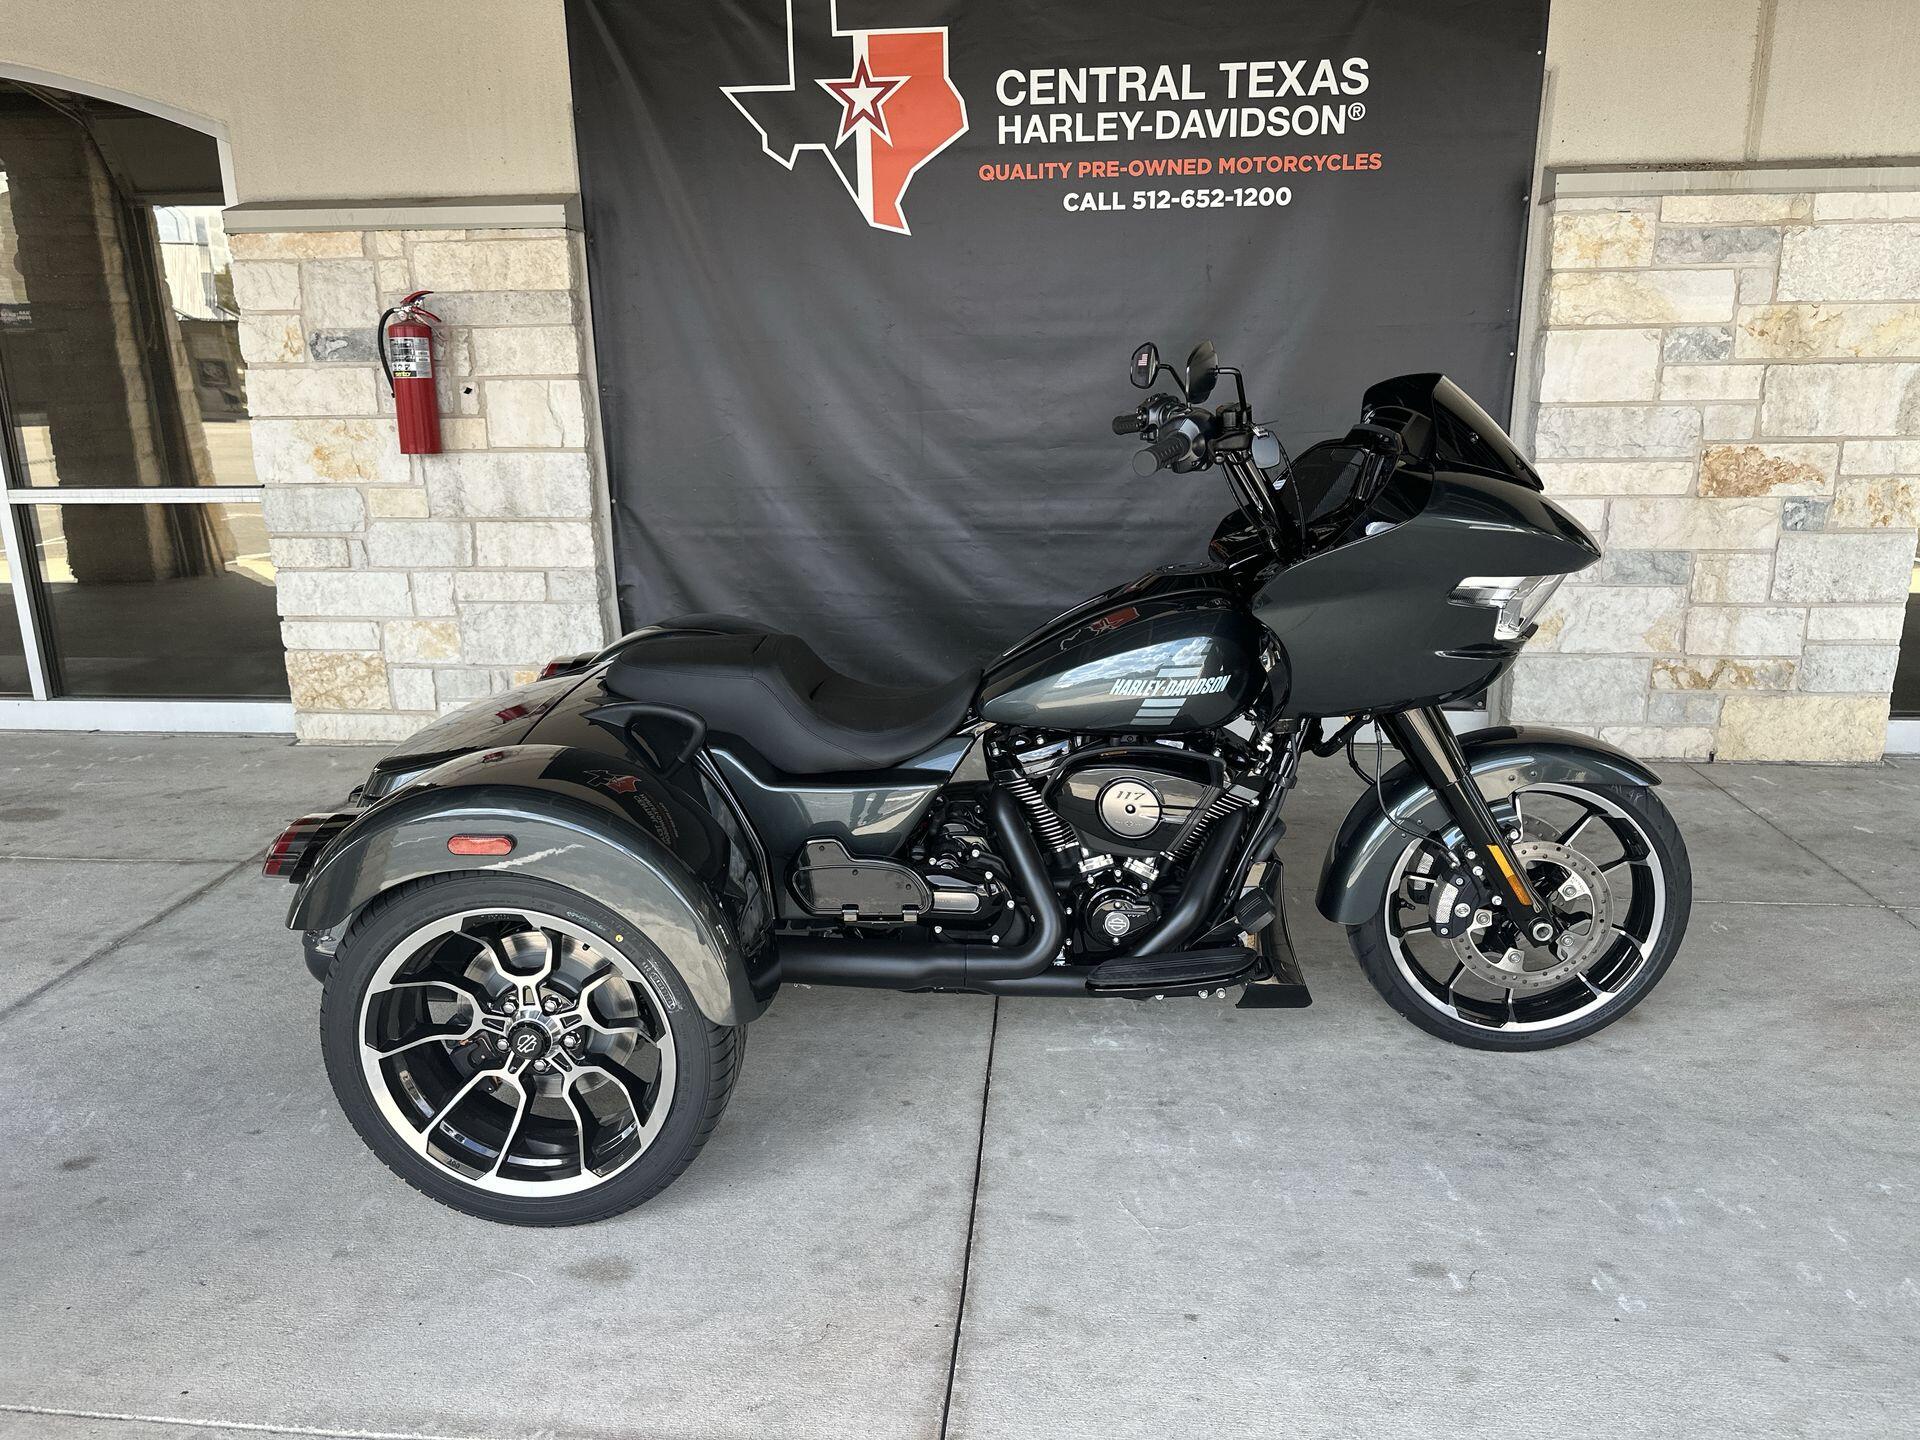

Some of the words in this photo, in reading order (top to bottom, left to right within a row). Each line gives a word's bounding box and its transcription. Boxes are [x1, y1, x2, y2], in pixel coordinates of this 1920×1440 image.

[995, 63, 1206, 107] CENTRAL
[1219, 57, 1370, 99] TEXAS
[978, 161, 1073, 182] QUALITY
[1078, 157, 1213, 179] PRE-OWNED
[1218, 152, 1383, 175] MOTORCYCLES
[1062, 191, 1126, 212] CALL
[1131, 186, 1292, 210] 512-652-1200
[1109, 675, 1232, 697] HARLEY-DAVIDSON
[1116, 790, 1146, 801] 117
